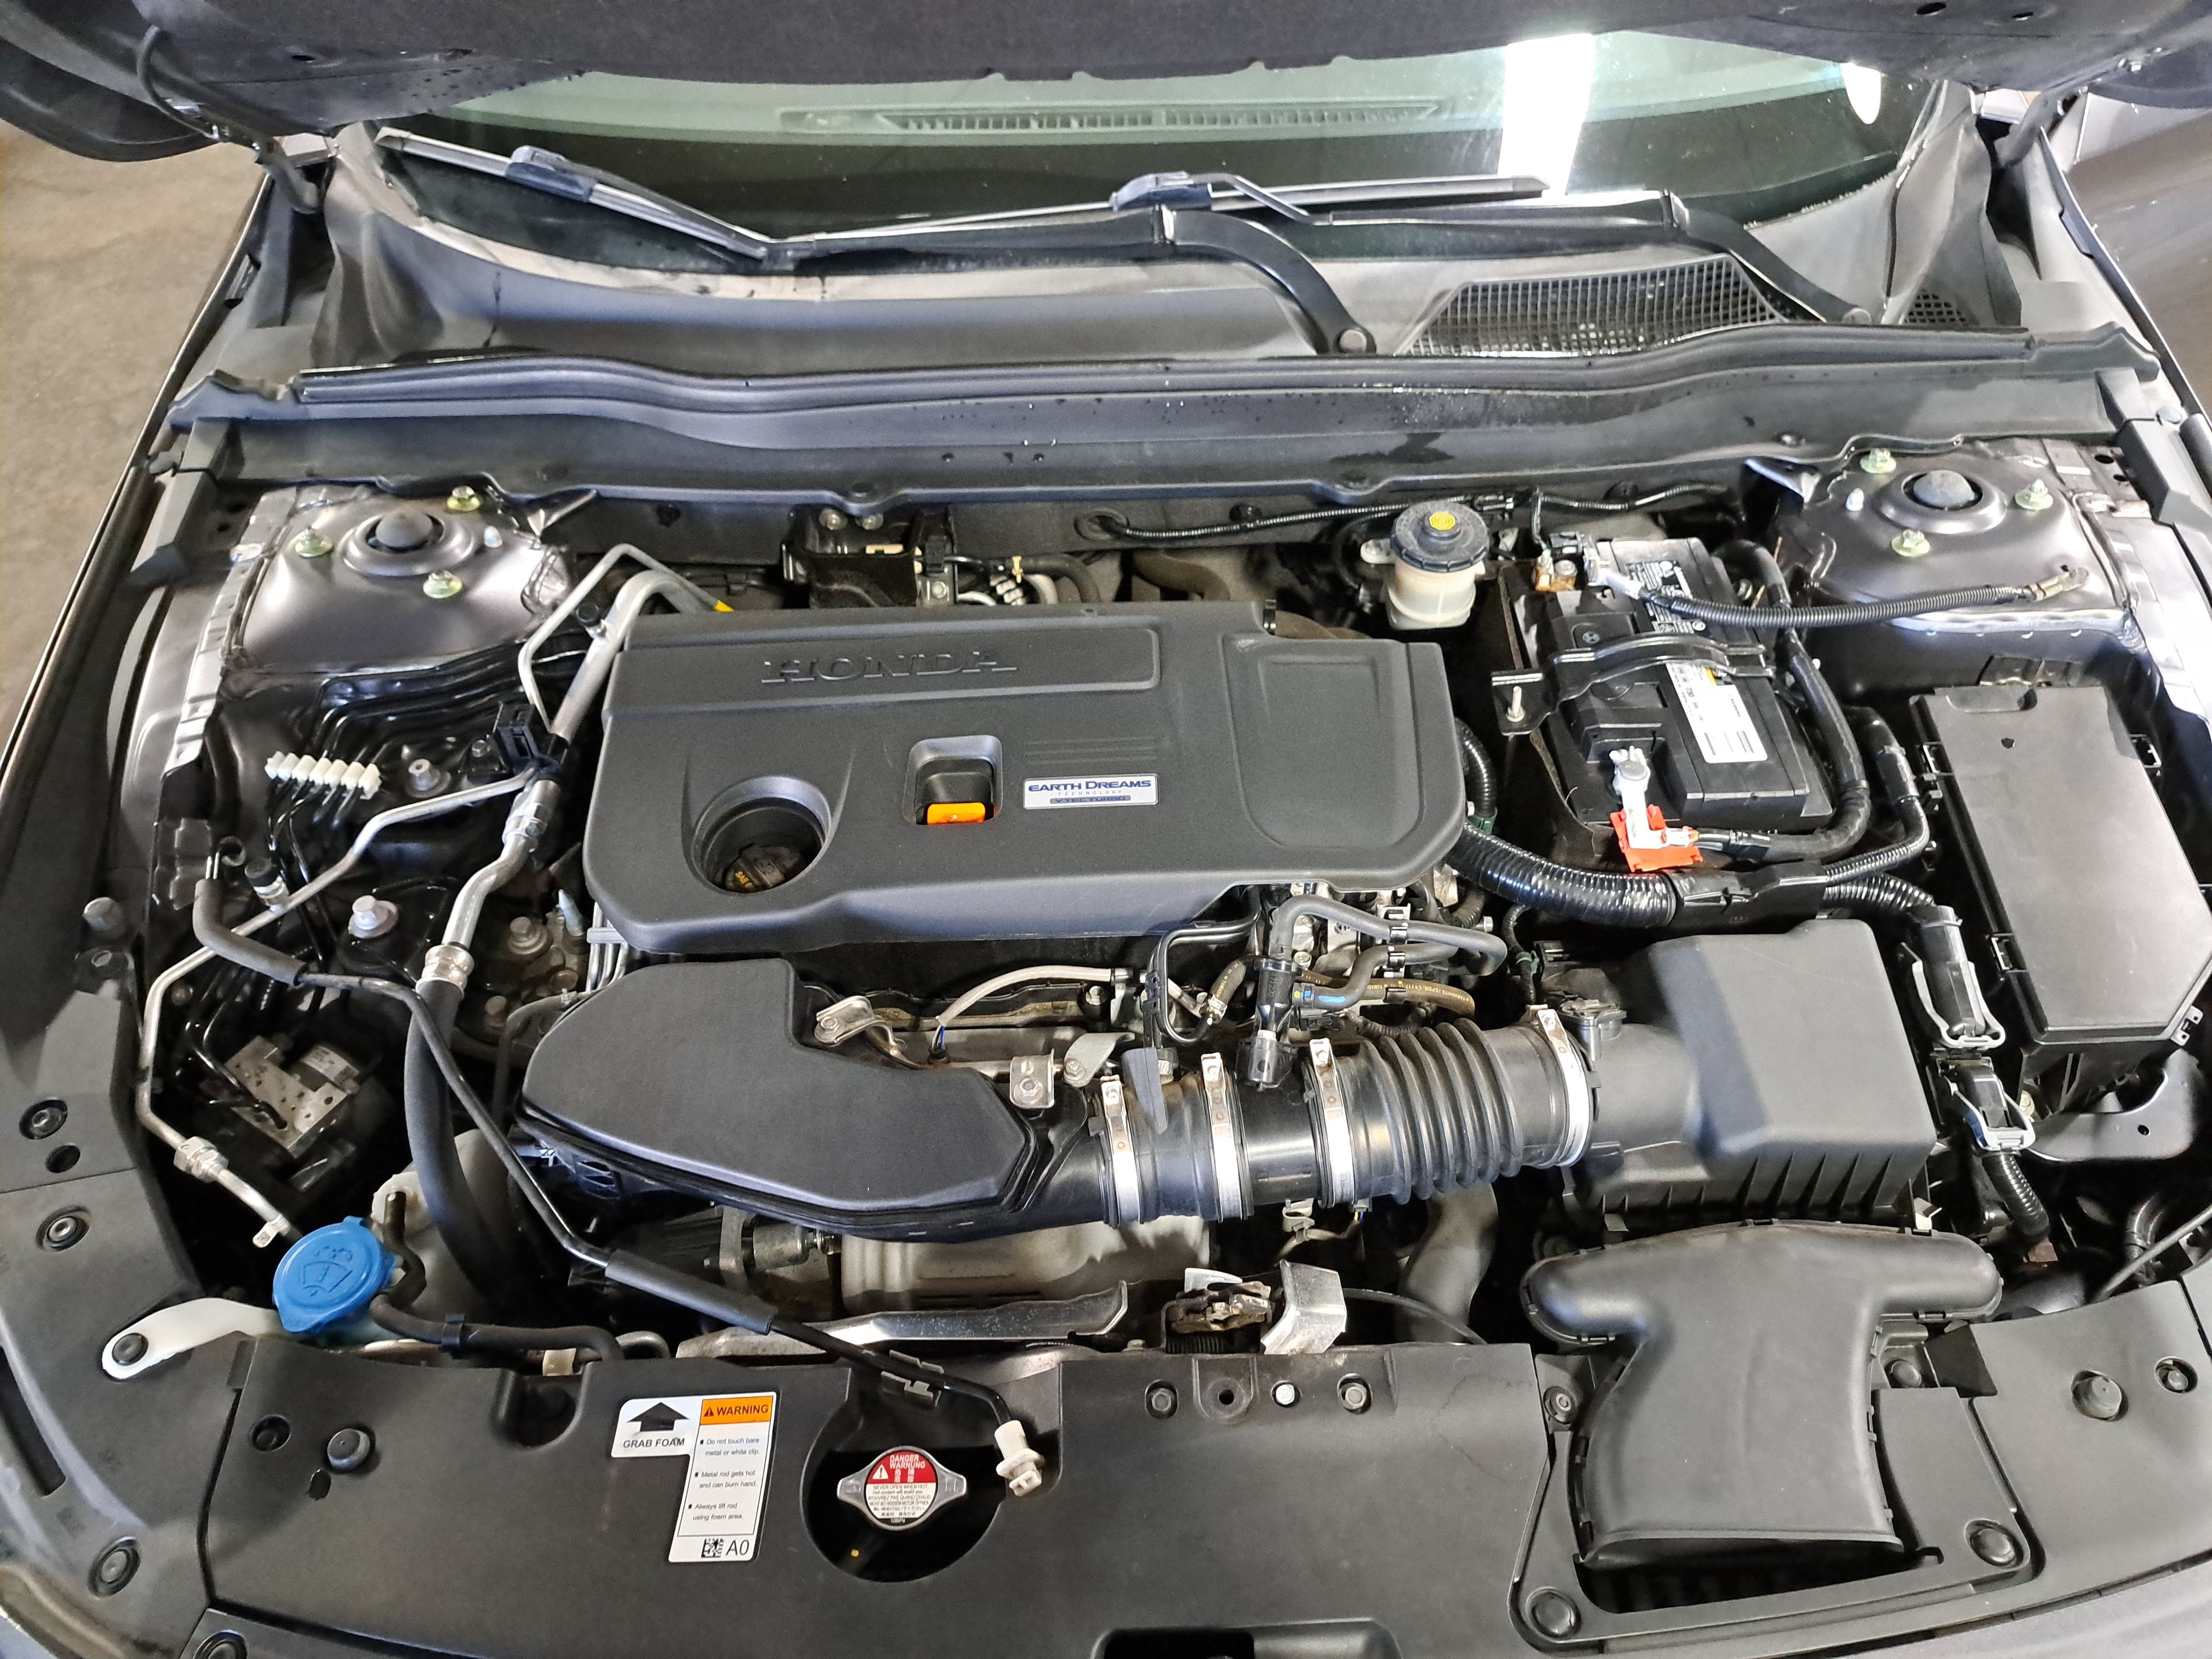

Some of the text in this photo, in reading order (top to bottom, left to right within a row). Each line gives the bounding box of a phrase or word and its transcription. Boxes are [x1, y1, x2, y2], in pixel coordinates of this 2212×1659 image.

[762, 651, 1017, 683] HONDA
[1028, 780, 1151, 792] EARTH DREAMS
[735, 871, 750, 884] SAE
[717, 1405, 769, 1416] WARNING
[623, 1438, 685, 1449] GRAB FOAM
[725, 1539, 750, 1557] A0
